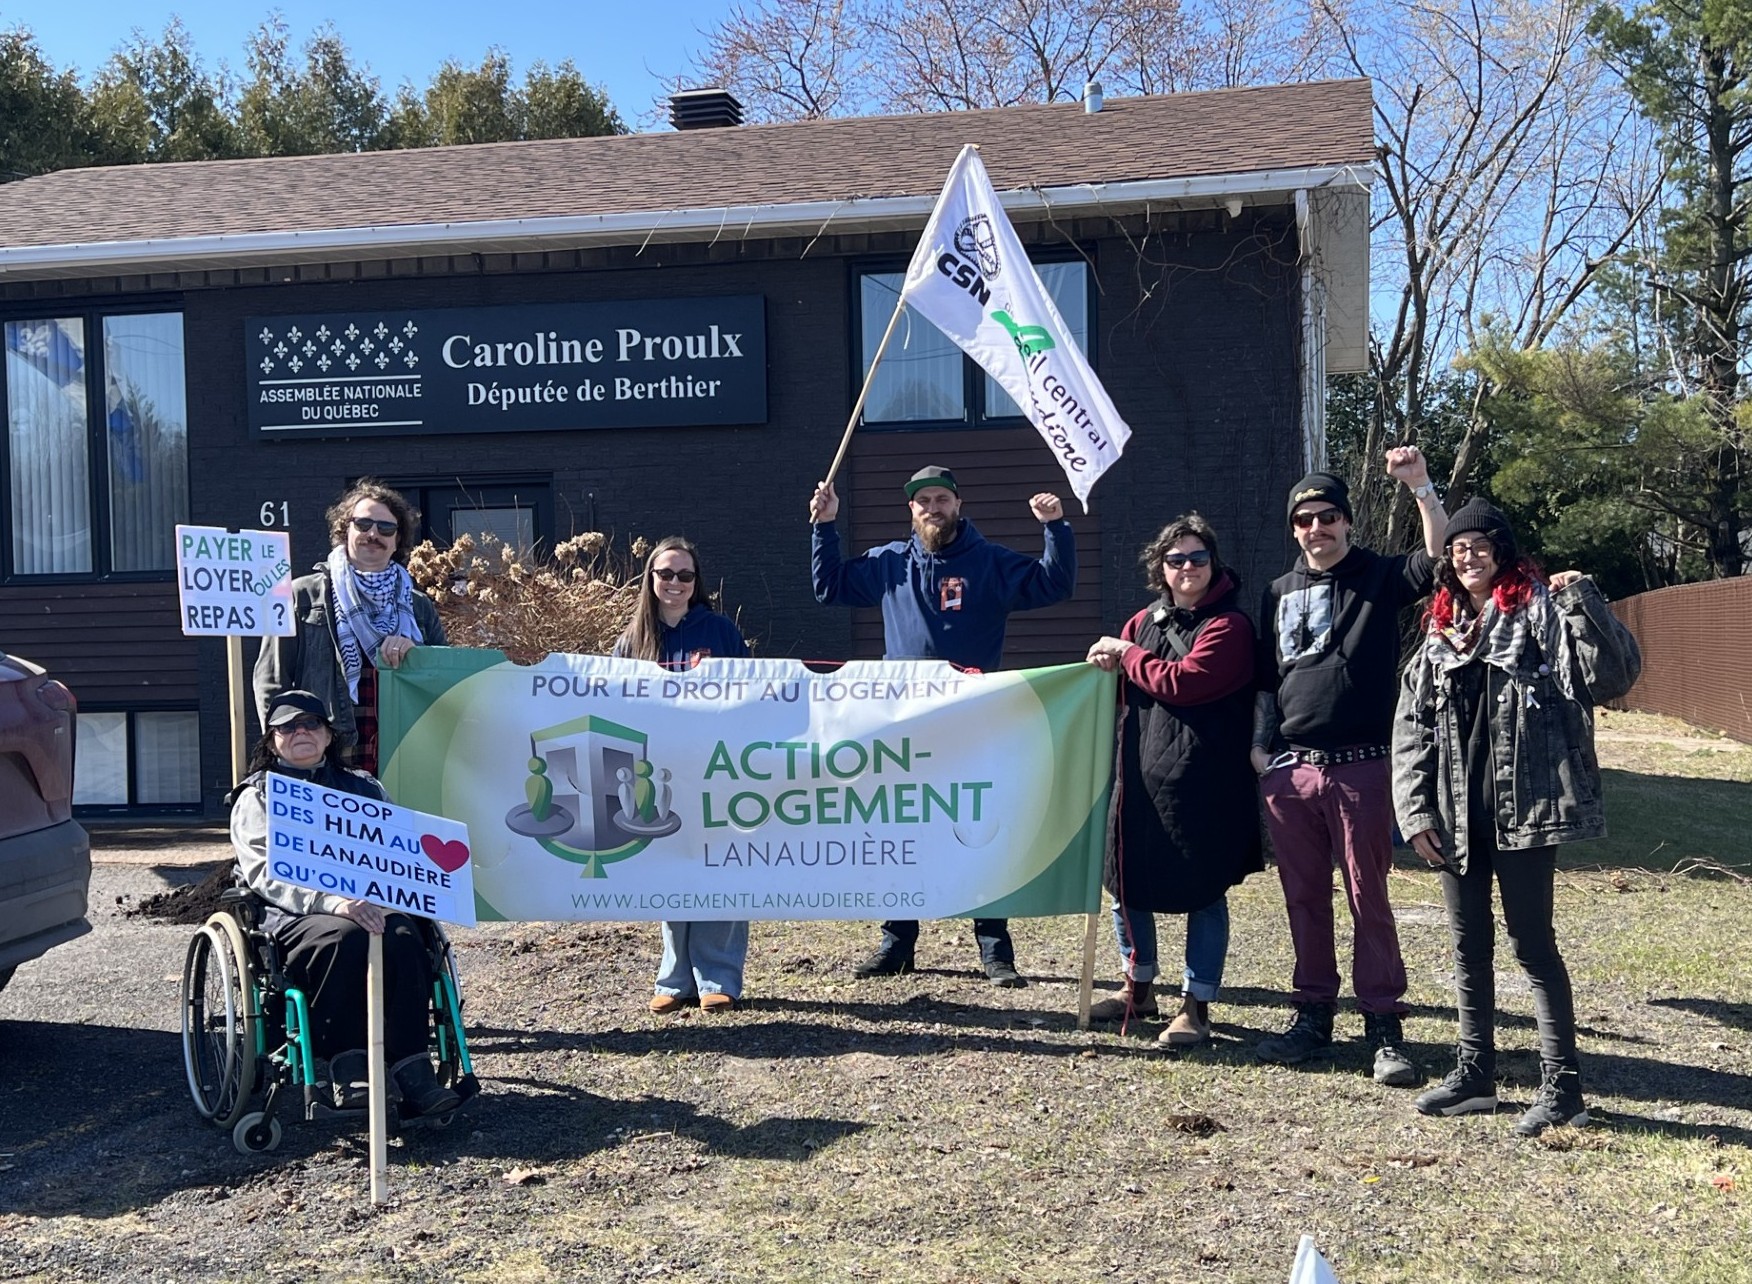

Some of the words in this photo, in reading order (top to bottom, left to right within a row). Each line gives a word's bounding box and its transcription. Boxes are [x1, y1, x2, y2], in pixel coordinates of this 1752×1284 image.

[937, 252, 991, 307] CSN
[442, 331, 604, 369] Caroline
[615, 325, 743, 361] Proulx
[259, 384, 341, 403] ASSEMBLÉE
[343, 383, 422, 399] NATIONALE
[302, 405, 321, 420] DU
[323, 402, 379, 420] QUÉBEC
[467, 379, 568, 411] Députée
[576, 378, 606, 401] de
[614, 374, 721, 400] Berthier
[1043, 375, 1108, 451] central
[260, 501, 290, 527] 61
[182, 534, 253, 561] PAYER
[261, 544, 275, 559] LE
[183, 566, 255, 593] LOYER
[253, 574, 273, 597] OU
[270, 558, 291, 581] LES
[187, 605, 256, 630] REPAS
[272, 602, 285, 627] ?
[532, 675, 610, 698] POUR
[622, 679, 650, 699] LE
[662, 680, 749, 702] DROIT
[760, 681, 801, 703] AU
[812, 679, 966, 702] LOGEMENT
[703, 736, 932, 781] ACTION-
[272, 778, 314, 803] DES
[322, 792, 393, 821] COOP
[702, 781, 993, 829] LOGEMENT
[273, 800, 315, 825] DES
[325, 813, 385, 846] HLM
[389, 834, 420, 855] AU
[274, 831, 304, 853] DE
[309, 839, 452, 889] LANAUDIÈRE
[703, 831, 917, 868] LANAUDIÈRE
[273, 860, 356, 894] QU'ON
[364, 880, 437, 914] AIME
[571, 891, 926, 910] WWW.LOGEMENTLANAUDIERE.ORG
